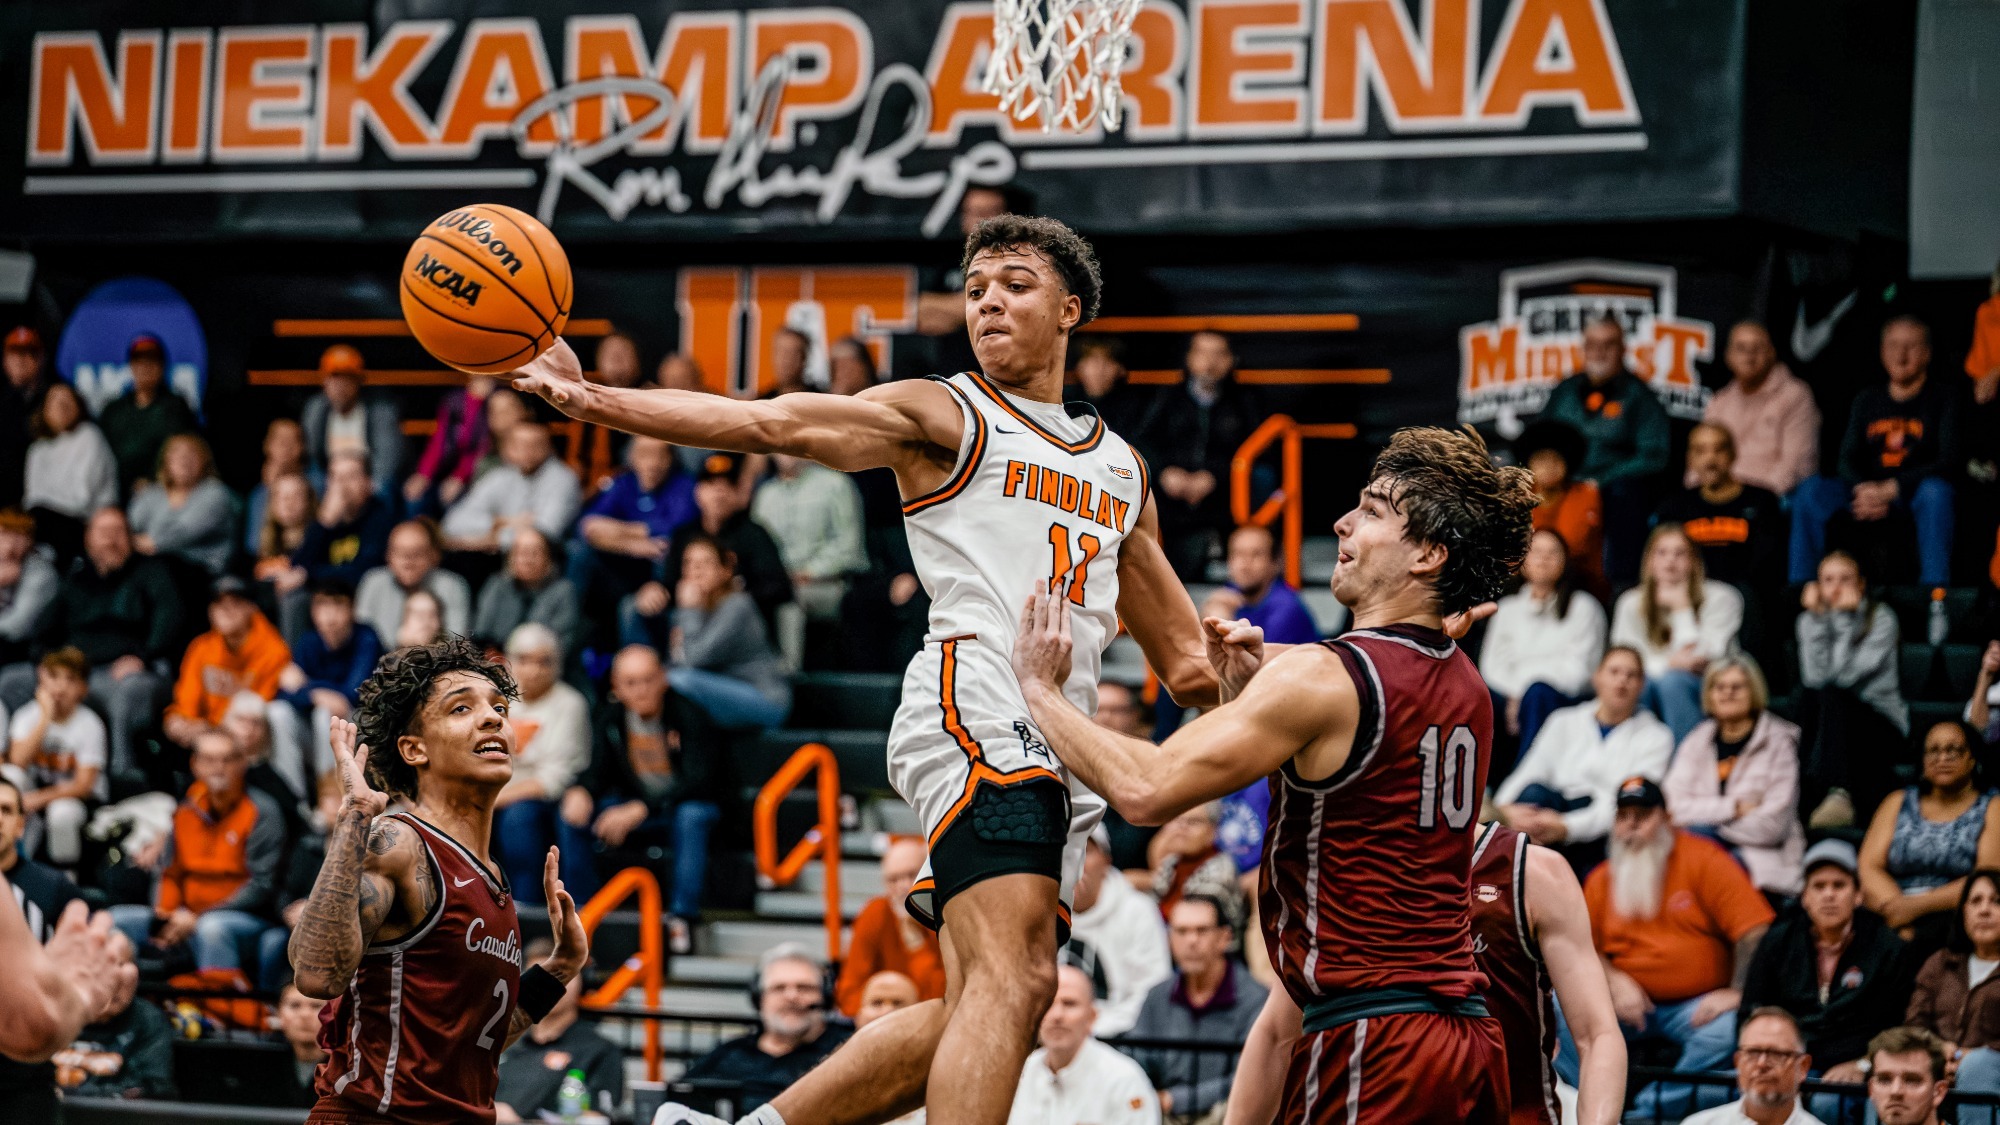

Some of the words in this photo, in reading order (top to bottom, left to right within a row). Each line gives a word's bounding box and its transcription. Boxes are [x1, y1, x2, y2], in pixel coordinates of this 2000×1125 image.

[27, 9, 874, 165] NIEKAMP
[922, 0, 1643, 147] ARENA
[415, 253, 484, 306] NCAA
[437, 211, 523, 277] Wilson
[1003, 459, 1130, 535] FINDLAY
[1049, 521, 1101, 608] 11
[1417, 723, 1478, 833] 10
[476, 978, 509, 1050] 2
